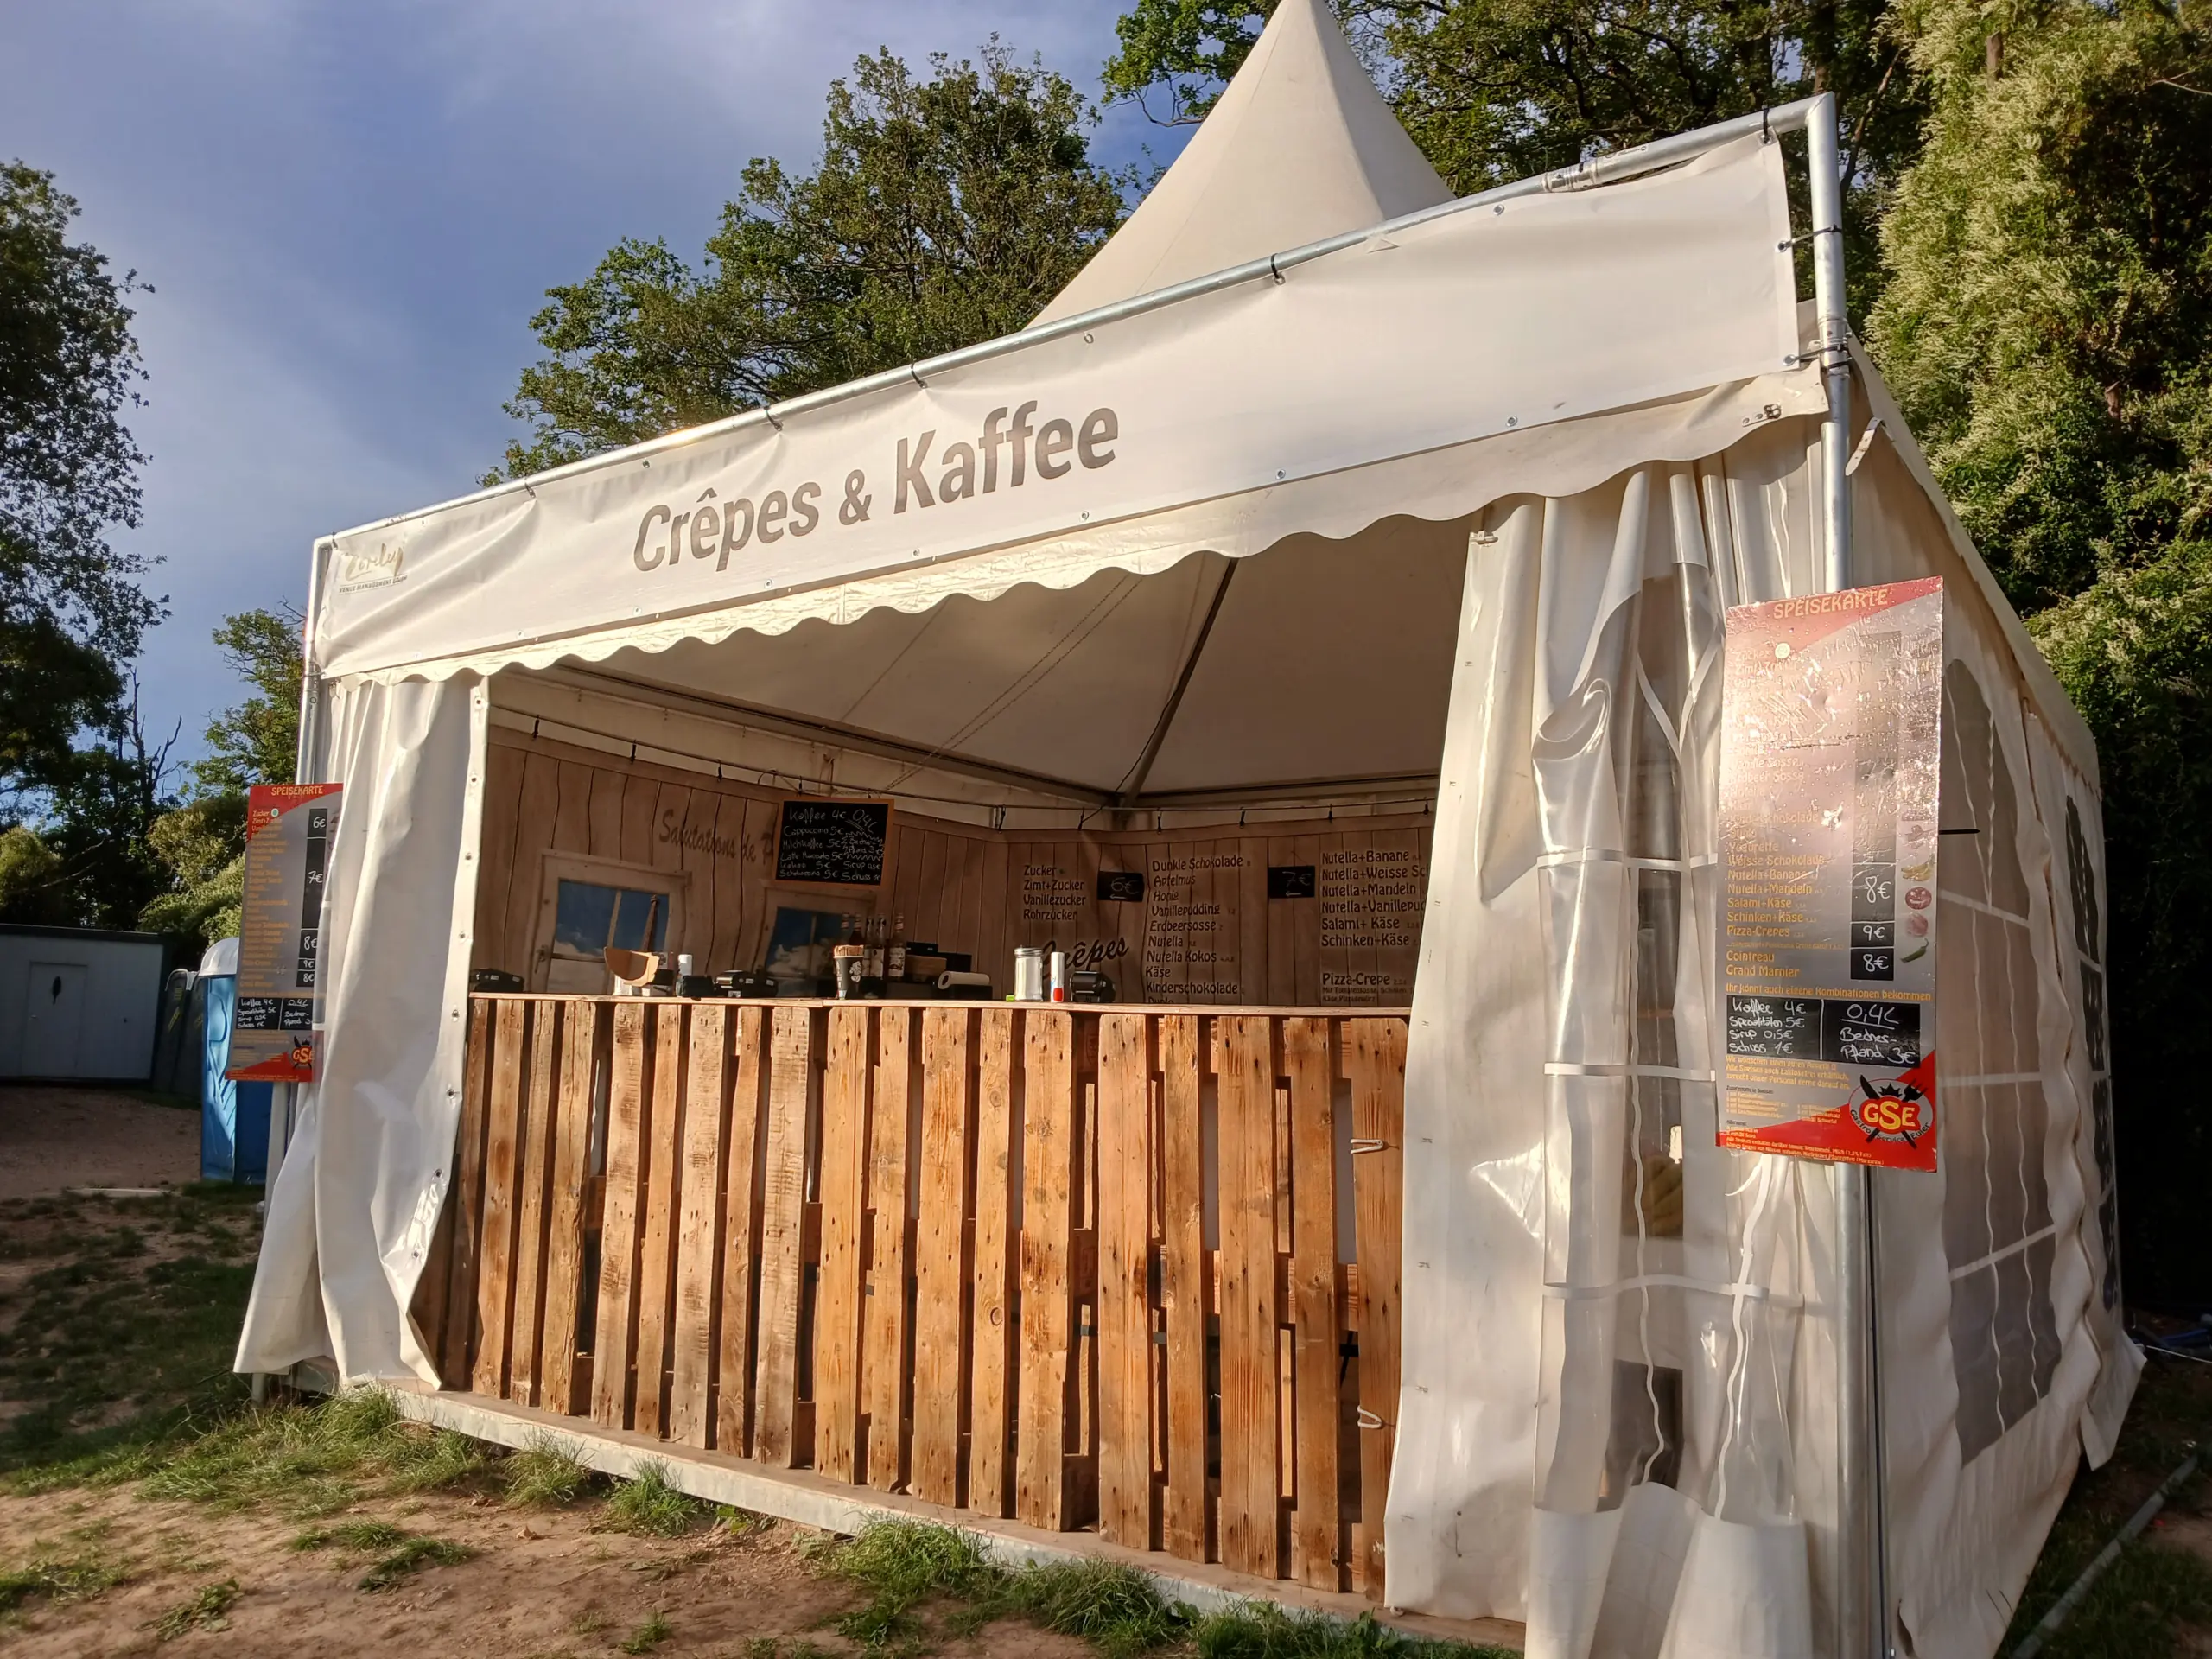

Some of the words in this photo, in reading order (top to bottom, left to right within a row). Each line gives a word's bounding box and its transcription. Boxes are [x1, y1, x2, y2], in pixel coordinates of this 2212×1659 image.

[633, 481, 822, 573] Crêpes
[838, 469, 873, 526] &
[893, 400, 1119, 515] Kaffee
[1773, 589, 1889, 620] SPEISEKARTE
[270, 785, 324, 797] SPEISEKARTE
[313, 817, 326, 829] 6€
[743, 833, 757, 863] de
[1153, 860, 1186, 872] Dunkle
[1189, 855, 1243, 870] Schokolade
[1322, 850, 1409, 864] Nutella+Banane
[1767, 855, 1824, 865] Schokolade
[1024, 865, 1057, 876] Zucker
[1322, 866, 1408, 881] Nutella+Weisse
[308, 871, 323, 884] 7€
[1154, 875, 1196, 887] Apfelmus
[1282, 870, 1312, 887] 7€
[1024, 880, 1084, 892] Zimt+Zucker
[1110, 876, 1140, 894] 6€
[1322, 882, 1416, 897] Nutella+Mandeln
[1866, 876, 1891, 904] 8€
[1023, 894, 1087, 906] Vanillezucker
[1153, 891, 1179, 902] Honig
[1023, 909, 1077, 921] Rohrzucker
[1152, 904, 1221, 917] Vanillepudding
[1149, 920, 1217, 931] Erdbeersosse
[1371, 917, 1400, 929] Käse
[1862, 925, 1885, 941] 9€
[304, 936, 317, 950] 8€
[1148, 935, 1183, 947] Nutella
[1321, 933, 1409, 947] Schinken+Käse
[1147, 951, 1182, 963] Nutella
[1185, 951, 1217, 963] Kokos
[1726, 950, 1775, 963] Cointreau
[1863, 953, 1889, 972] 8€
[1146, 965, 1171, 978] Käse
[1726, 964, 1756, 976] Grand
[1759, 966, 1799, 977] Marnier
[303, 974, 314, 982] 8€
[1323, 972, 1390, 985] Pizza-Crepe
[1146, 981, 1238, 994] Kinderschokolade
[1726, 982, 1737, 992] Ihr
[1816, 988, 1879, 999] Kombinationen
[1883, 990, 1931, 1001] bekommen
[1732, 997, 1773, 1018] Kaffee
[1784, 1001, 1806, 1015] 4€
[1785, 1017, 1805, 1028] 5€
[1775, 1041, 1793, 1054] 1€
[1840, 1044, 1885, 1063] Pfand
[1887, 1047, 1916, 1064] 3€
[293, 1047, 315, 1064] GSE
[1864, 1101, 1916, 1129] GSE
[1850, 1109, 1872, 1134] Gastro
[1876, 1134, 1905, 1142] Service
[1910, 1122, 1930, 1139] Euler
